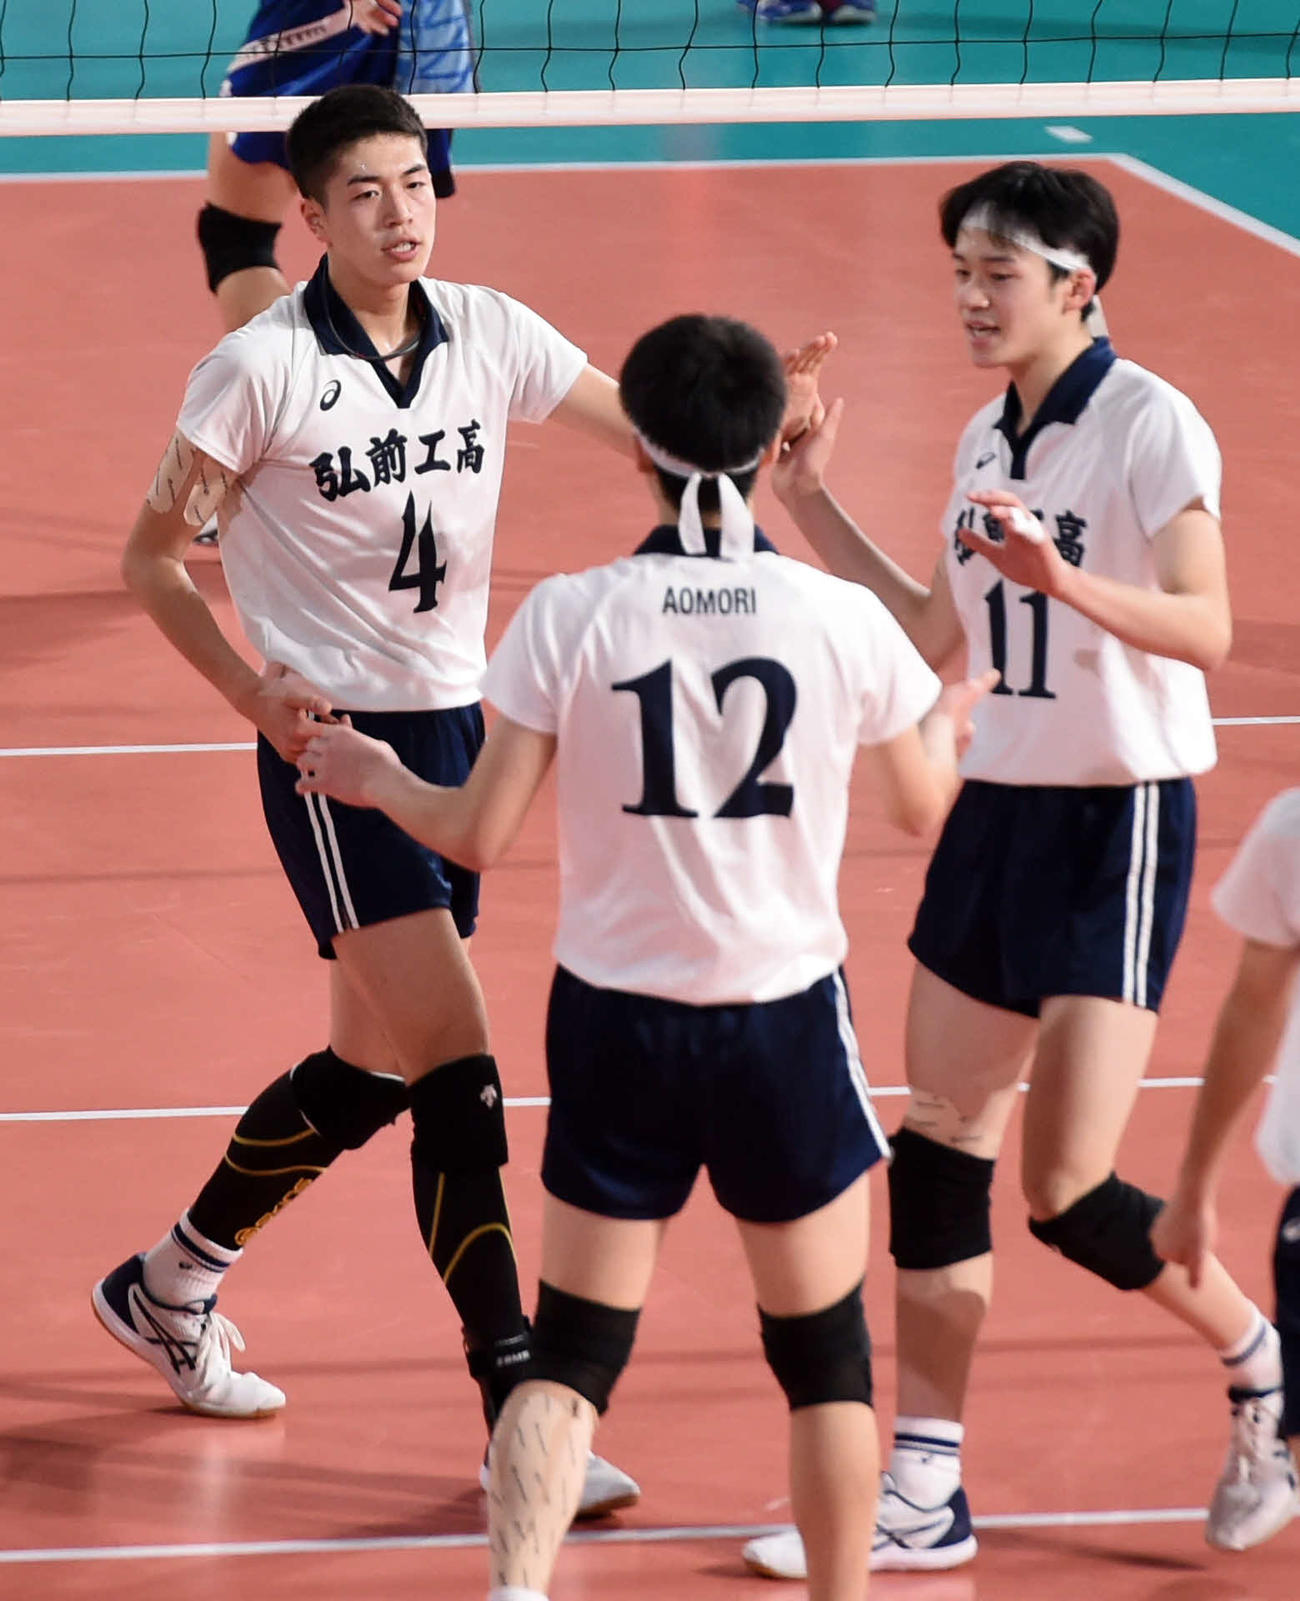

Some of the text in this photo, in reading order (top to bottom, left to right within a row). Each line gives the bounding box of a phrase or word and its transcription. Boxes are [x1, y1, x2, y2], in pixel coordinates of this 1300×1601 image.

[309, 419, 485, 502] 弘前工高
[389, 490, 447, 613] 4
[662, 586, 757, 614] AOMORI
[985, 578, 1056, 699] 11
[611, 656, 797, 818] 12
